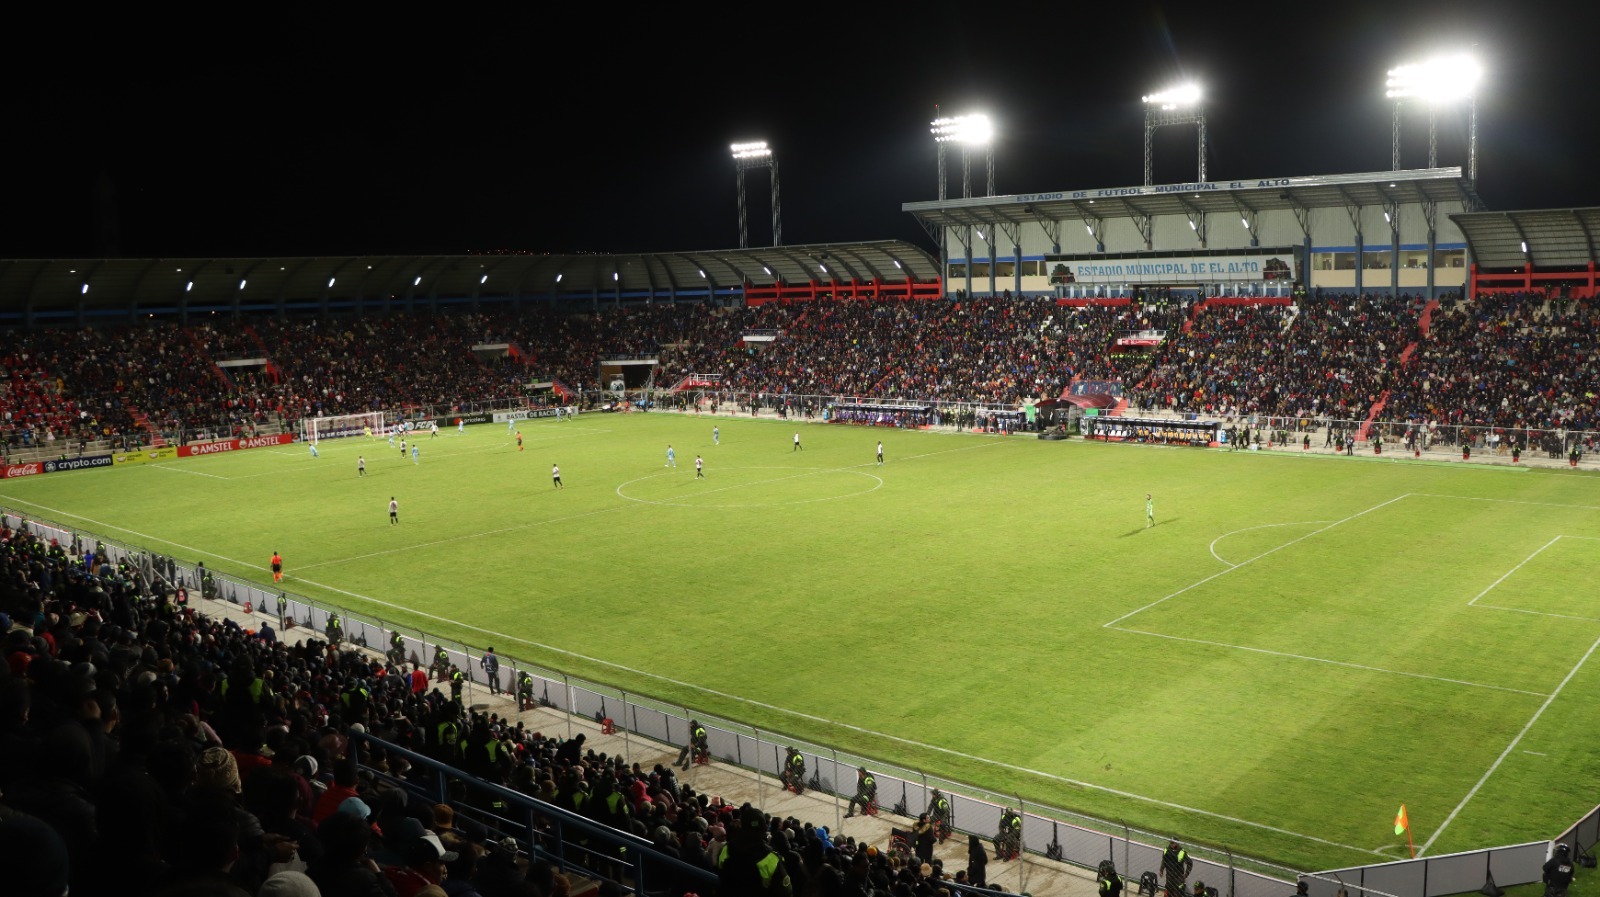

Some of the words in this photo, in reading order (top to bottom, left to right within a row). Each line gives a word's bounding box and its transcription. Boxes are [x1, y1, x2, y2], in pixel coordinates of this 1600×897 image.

[1016, 193, 1063, 202] ESTADIO
[1097, 188, 1145, 197] FUTBOL
[1155, 183, 1219, 193] MUNICIPAL
[1257, 179, 1290, 188] ALTO
[1077, 265, 1123, 276] ESTADIO
[1126, 263, 1188, 275] MUNICIPAL
[1191, 262, 1206, 273] DE
[1209, 262, 1225, 273] EL
[1228, 261, 1259, 273] ALTO
[200, 441, 233, 454] AMSTEL
[248, 436, 280, 448] AMSTEL
[58, 457, 111, 470] crypto.com
